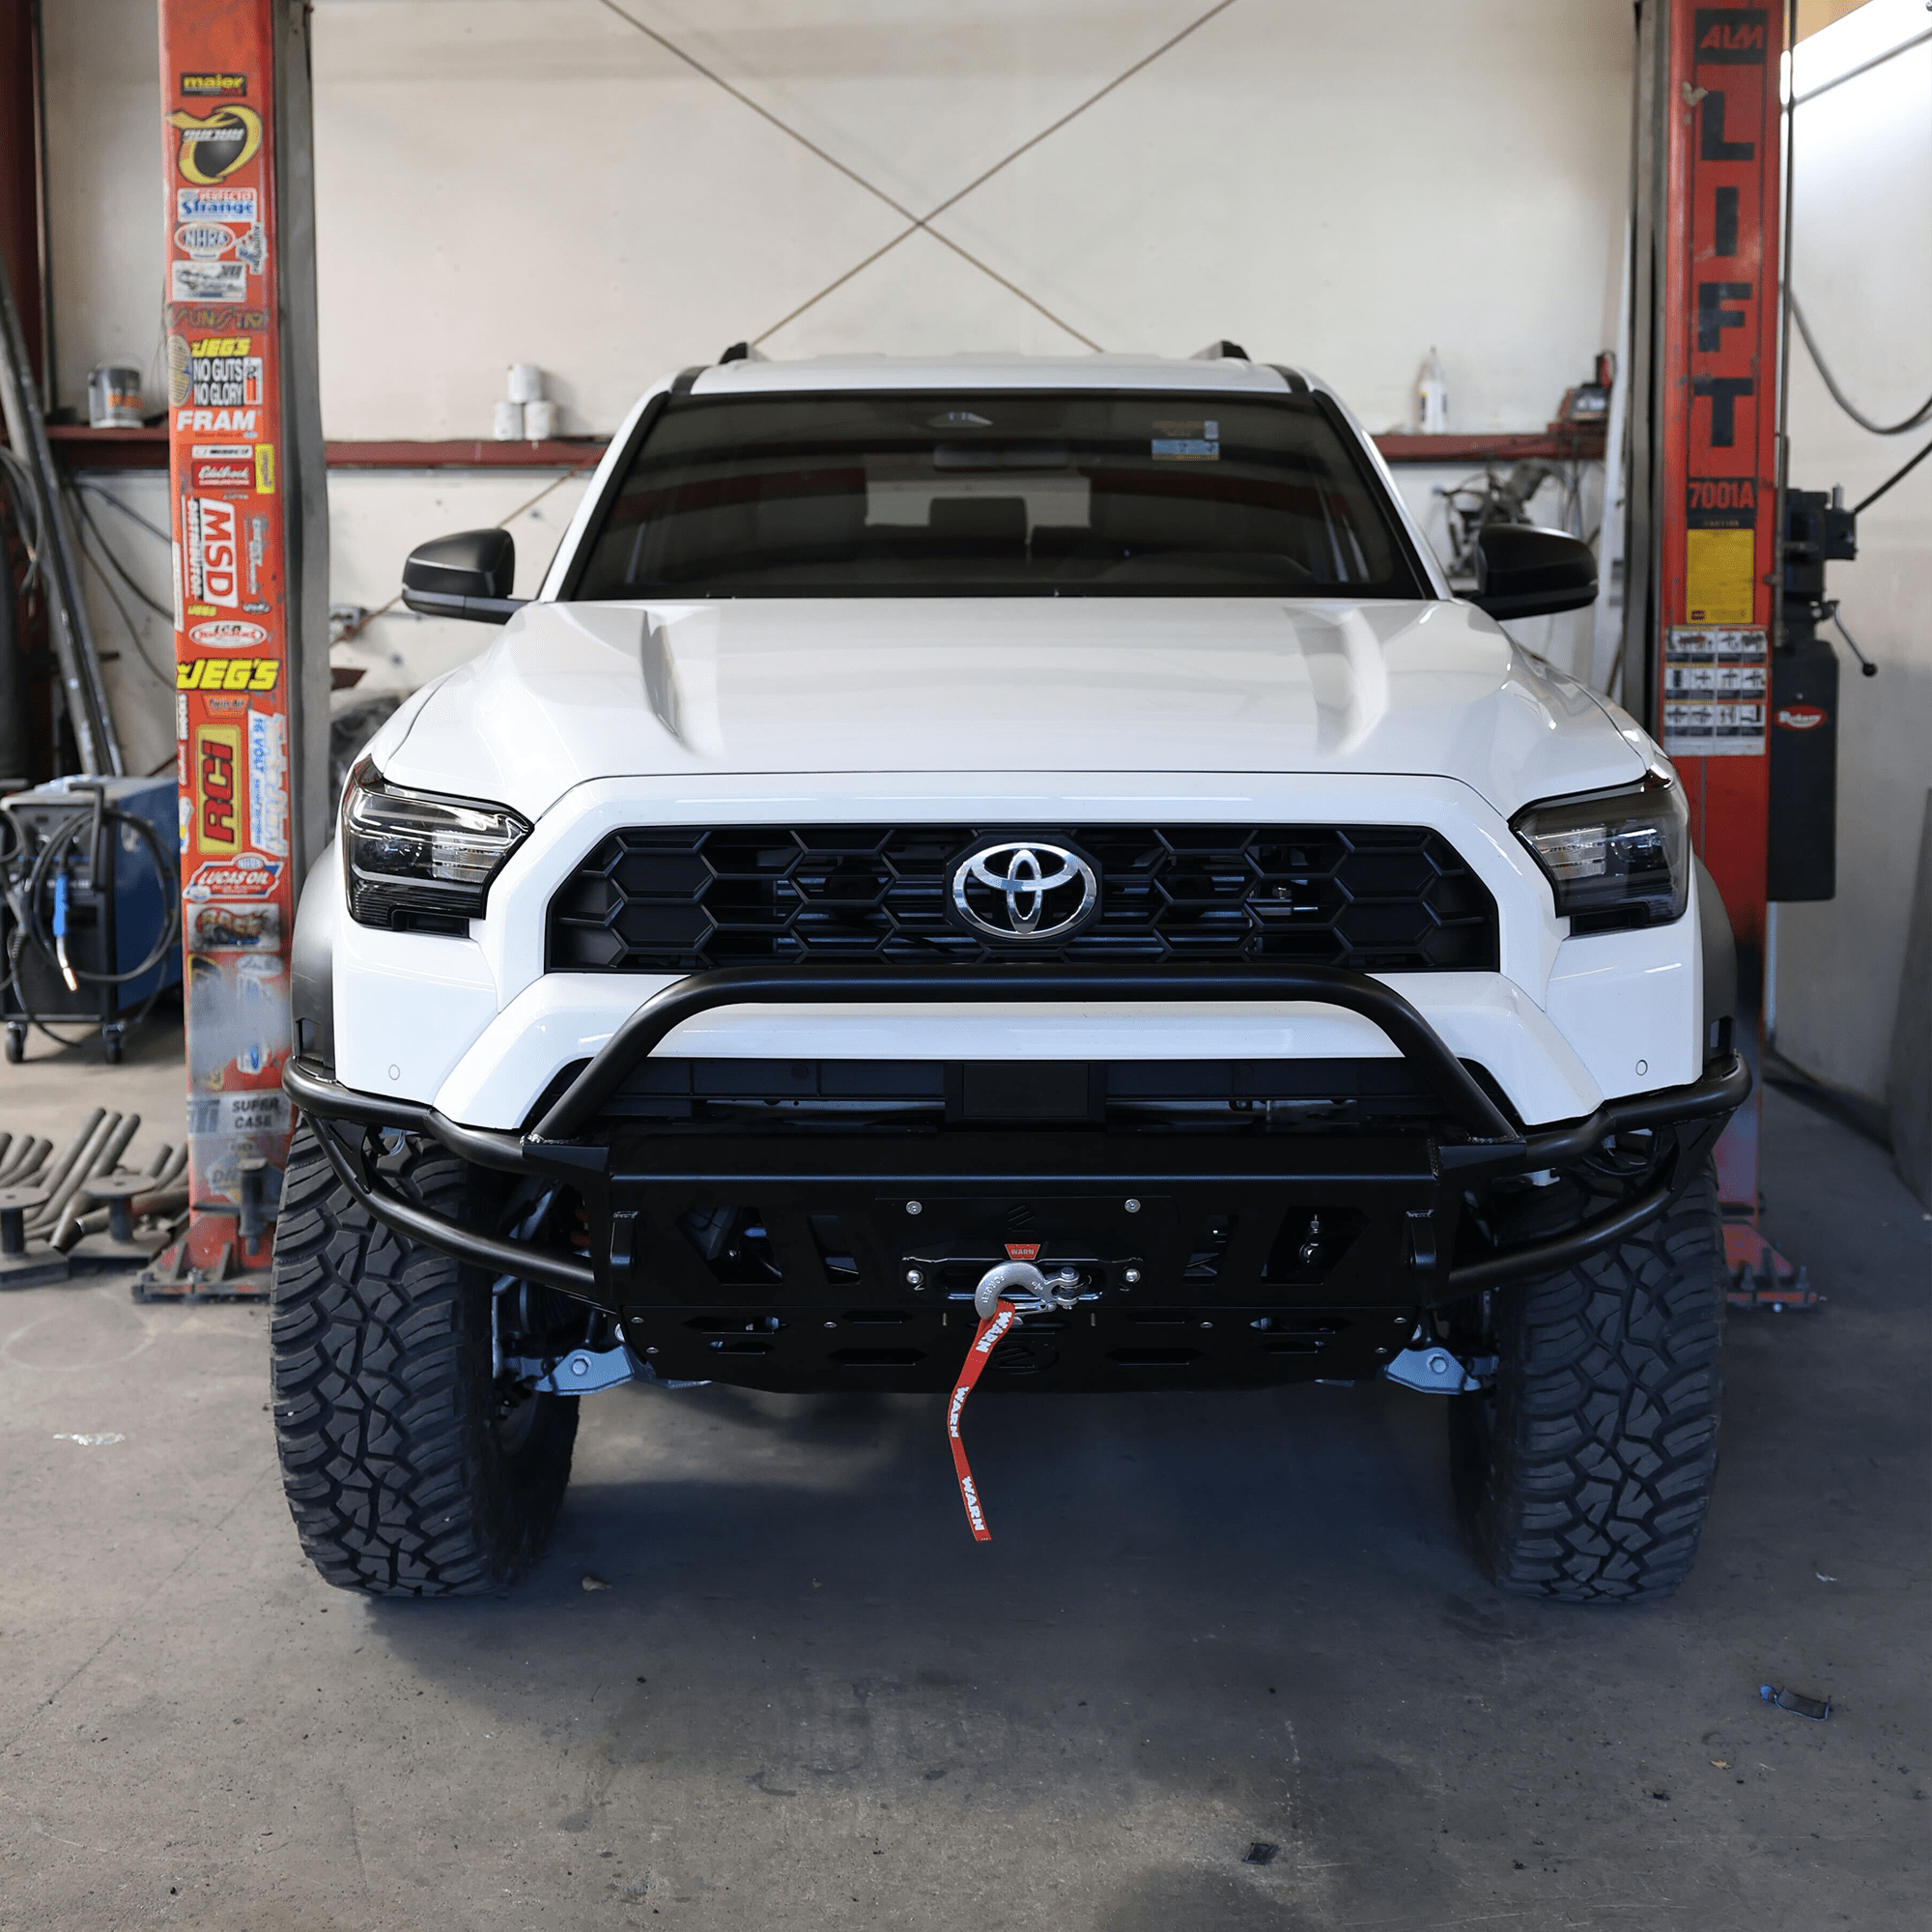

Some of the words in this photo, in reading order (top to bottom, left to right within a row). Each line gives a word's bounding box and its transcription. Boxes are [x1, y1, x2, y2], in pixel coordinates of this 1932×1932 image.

[185, 229, 228, 247] NHRA
[1694, 91, 1755, 447] LIFT
[194, 358, 211, 382] NO
[213, 358, 242, 382] GUTS
[195, 383, 210, 406] NO
[211, 383, 242, 406] GLORY
[177, 410, 255, 432] FRAM
[1690, 481, 1755, 509] 7001A
[203, 508, 234, 597] MSD
[177, 658, 280, 690] JEG'S
[197, 870, 246, 886] LUCAS
[245, 870, 270, 885] OIL
[232, 1097, 279, 1113] SUPER
[235, 1114, 272, 1129] CASE
[976, 1311, 1012, 1353] WARN
[950, 1386, 970, 1438] WARN
[962, 1476, 985, 1531] WARN
